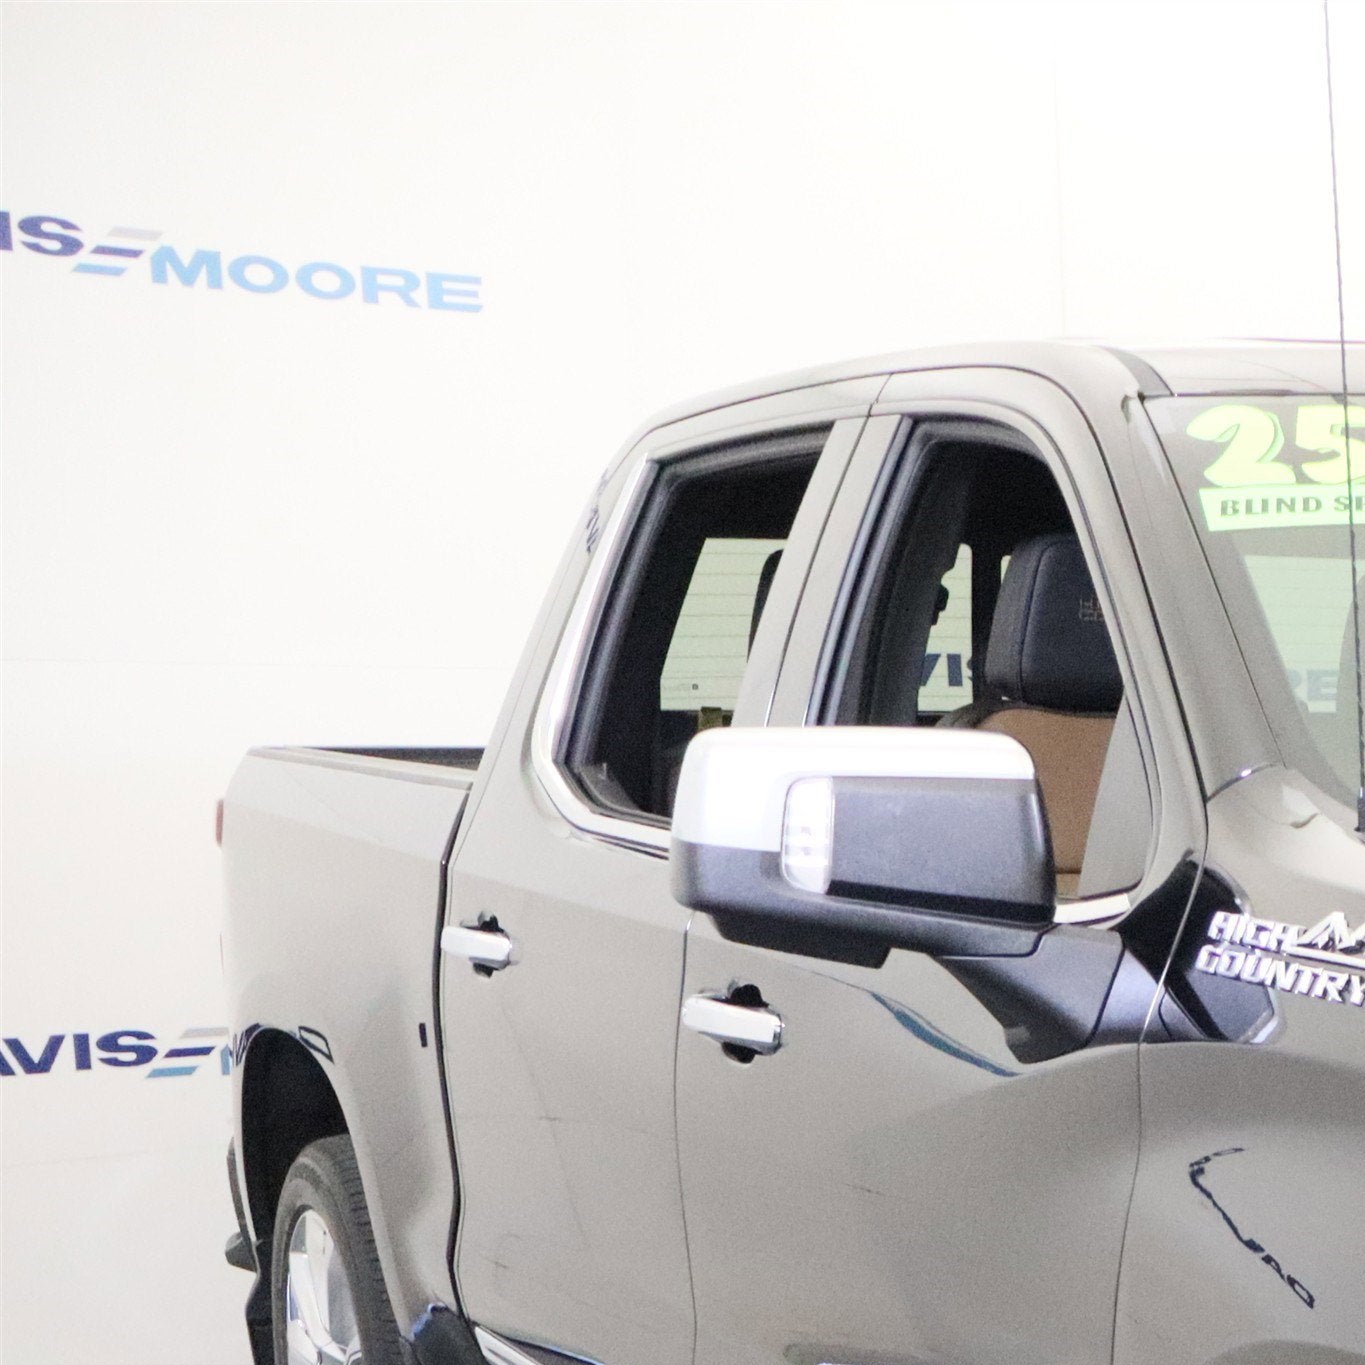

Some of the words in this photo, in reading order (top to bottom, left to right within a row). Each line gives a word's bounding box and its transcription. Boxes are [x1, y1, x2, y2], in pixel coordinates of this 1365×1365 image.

[150, 245, 484, 313] MOORE
[1219, 496, 1323, 517] BLIND
[1207, 910, 1308, 951] HIGH
